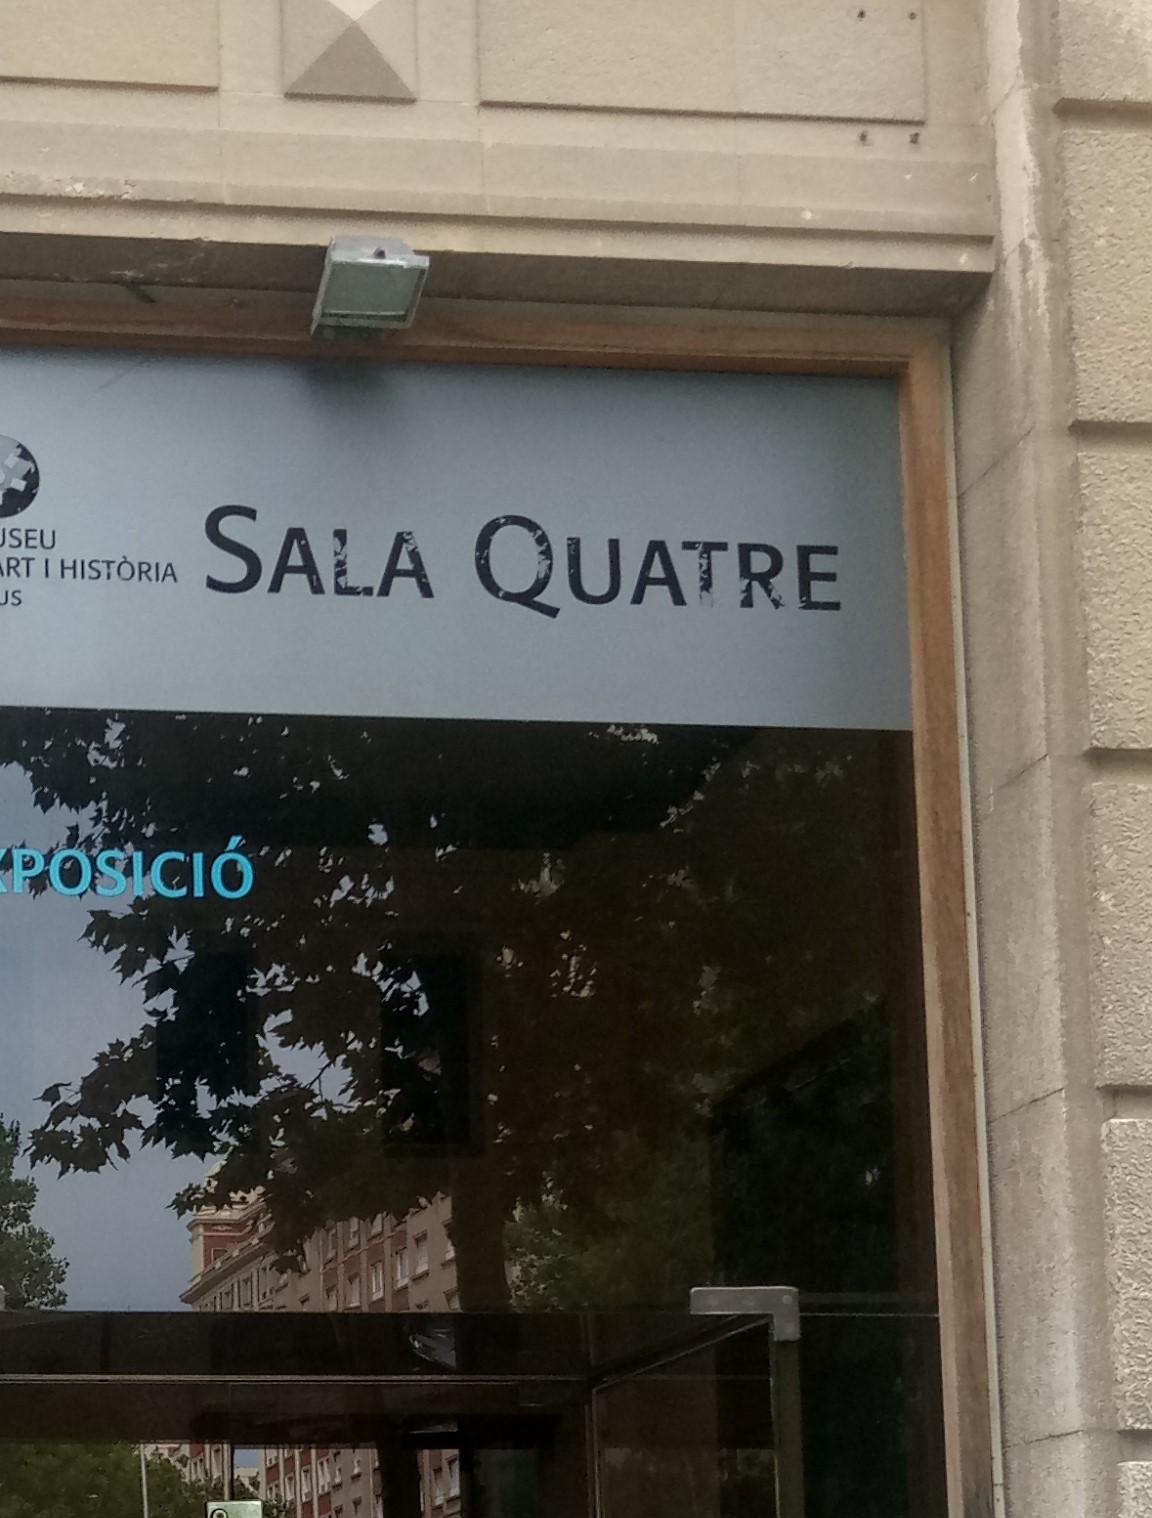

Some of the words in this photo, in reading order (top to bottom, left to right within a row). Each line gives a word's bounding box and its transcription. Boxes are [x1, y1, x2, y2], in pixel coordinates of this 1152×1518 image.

[44, 557, 51, 579] I
[60, 555, 178, 583] HISTÒRIA
[204, 504, 435, 599] SALA
[474, 515, 841, 619] QUATRE
